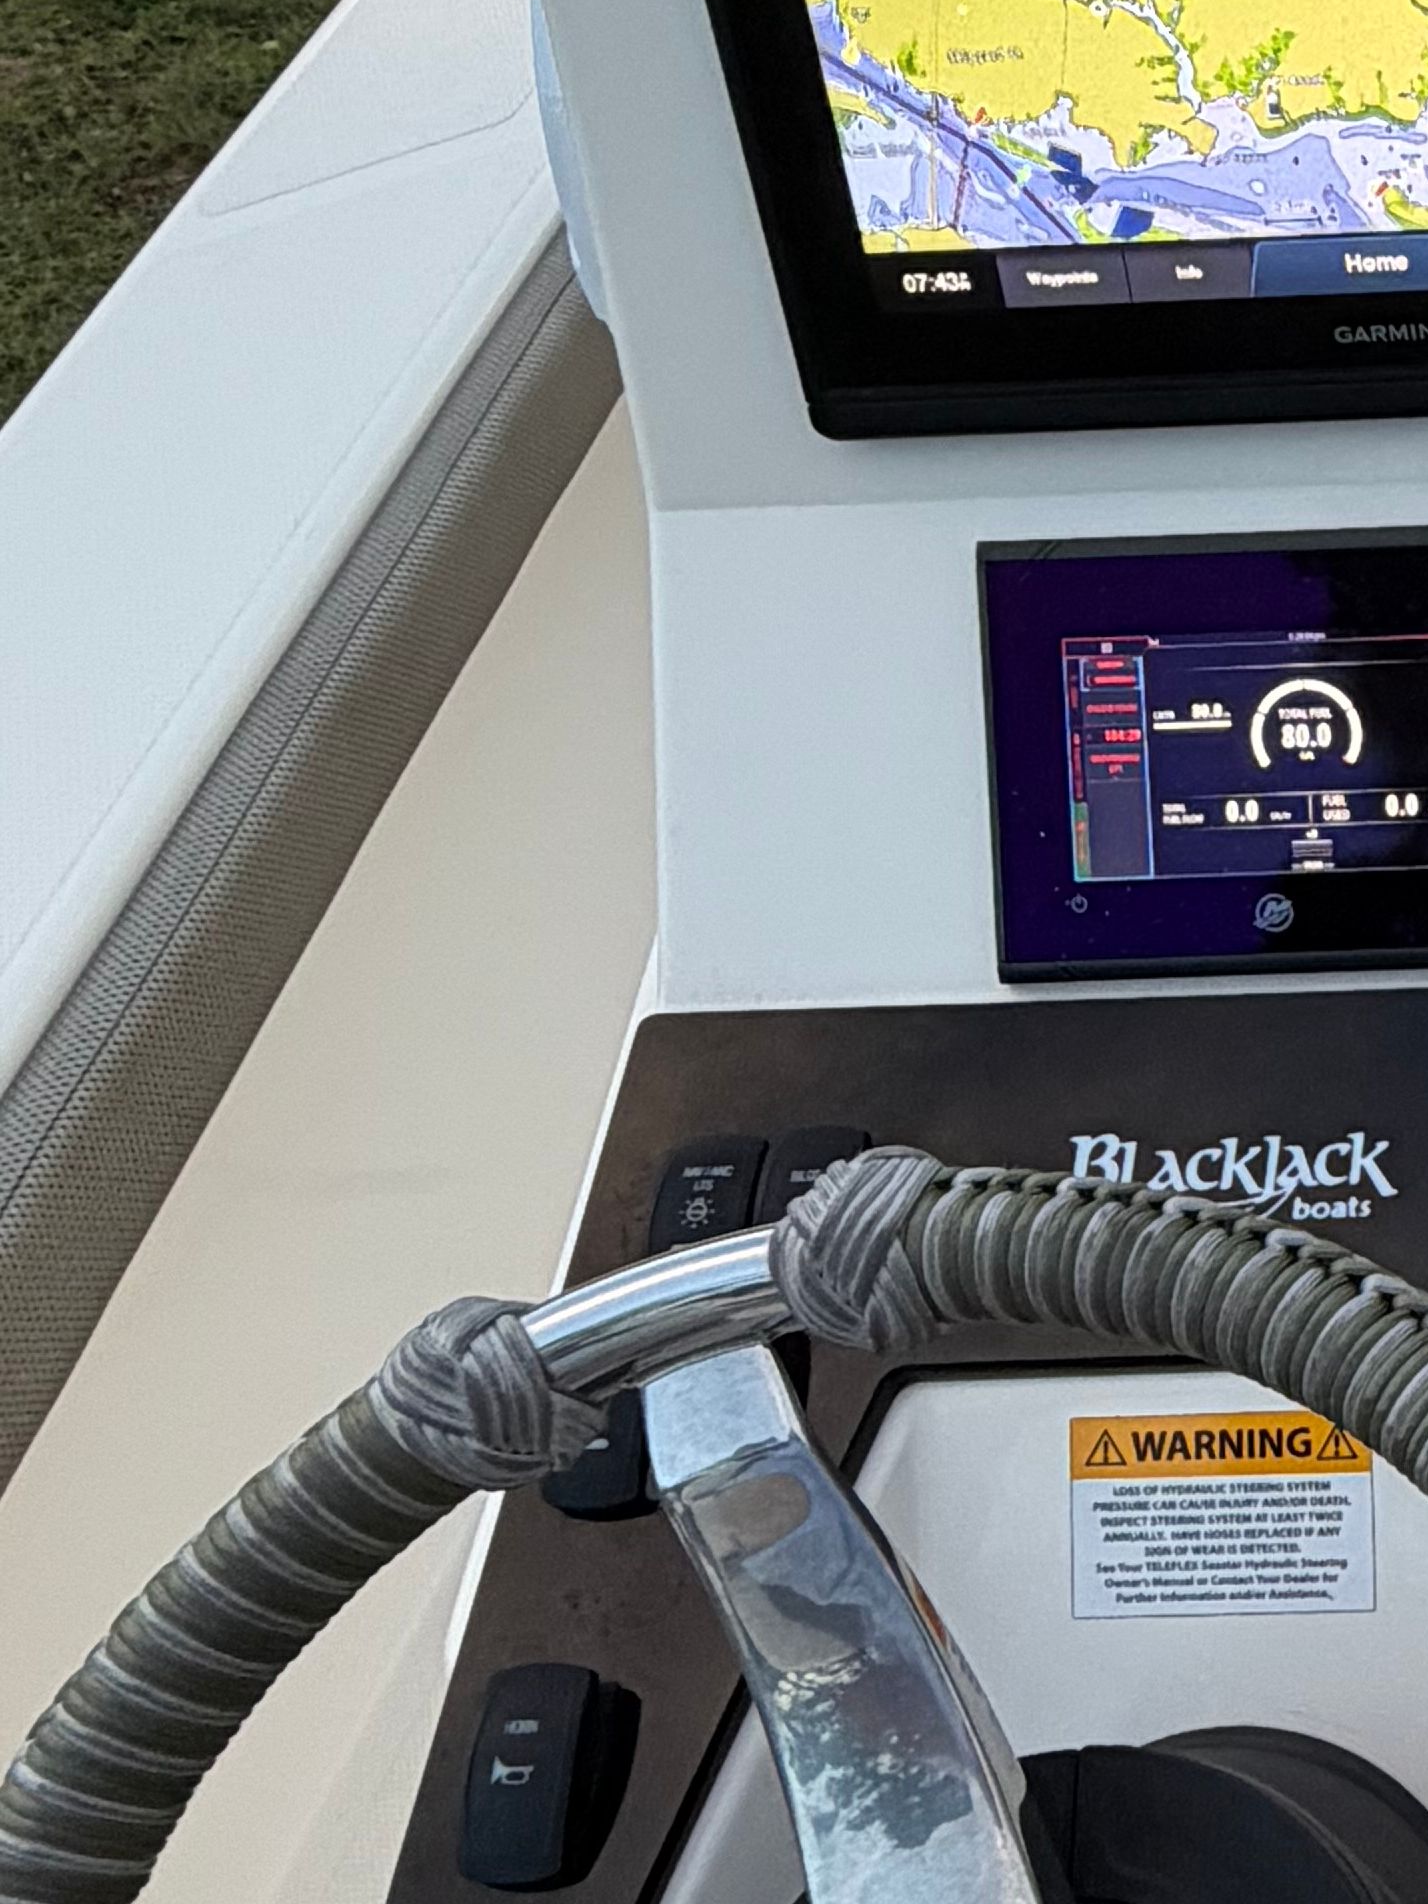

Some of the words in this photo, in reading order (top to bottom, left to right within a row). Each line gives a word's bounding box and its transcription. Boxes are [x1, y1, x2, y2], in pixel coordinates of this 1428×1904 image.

[1345, 252, 1409, 274] Home
[1281, 722, 1332, 749] 80.0
[1225, 799, 1259, 823] 0.0
[1384, 792, 1420, 818] 0.0
[1292, 1196, 1372, 1220] boats
[1132, 1427, 1312, 1463] WARNING
